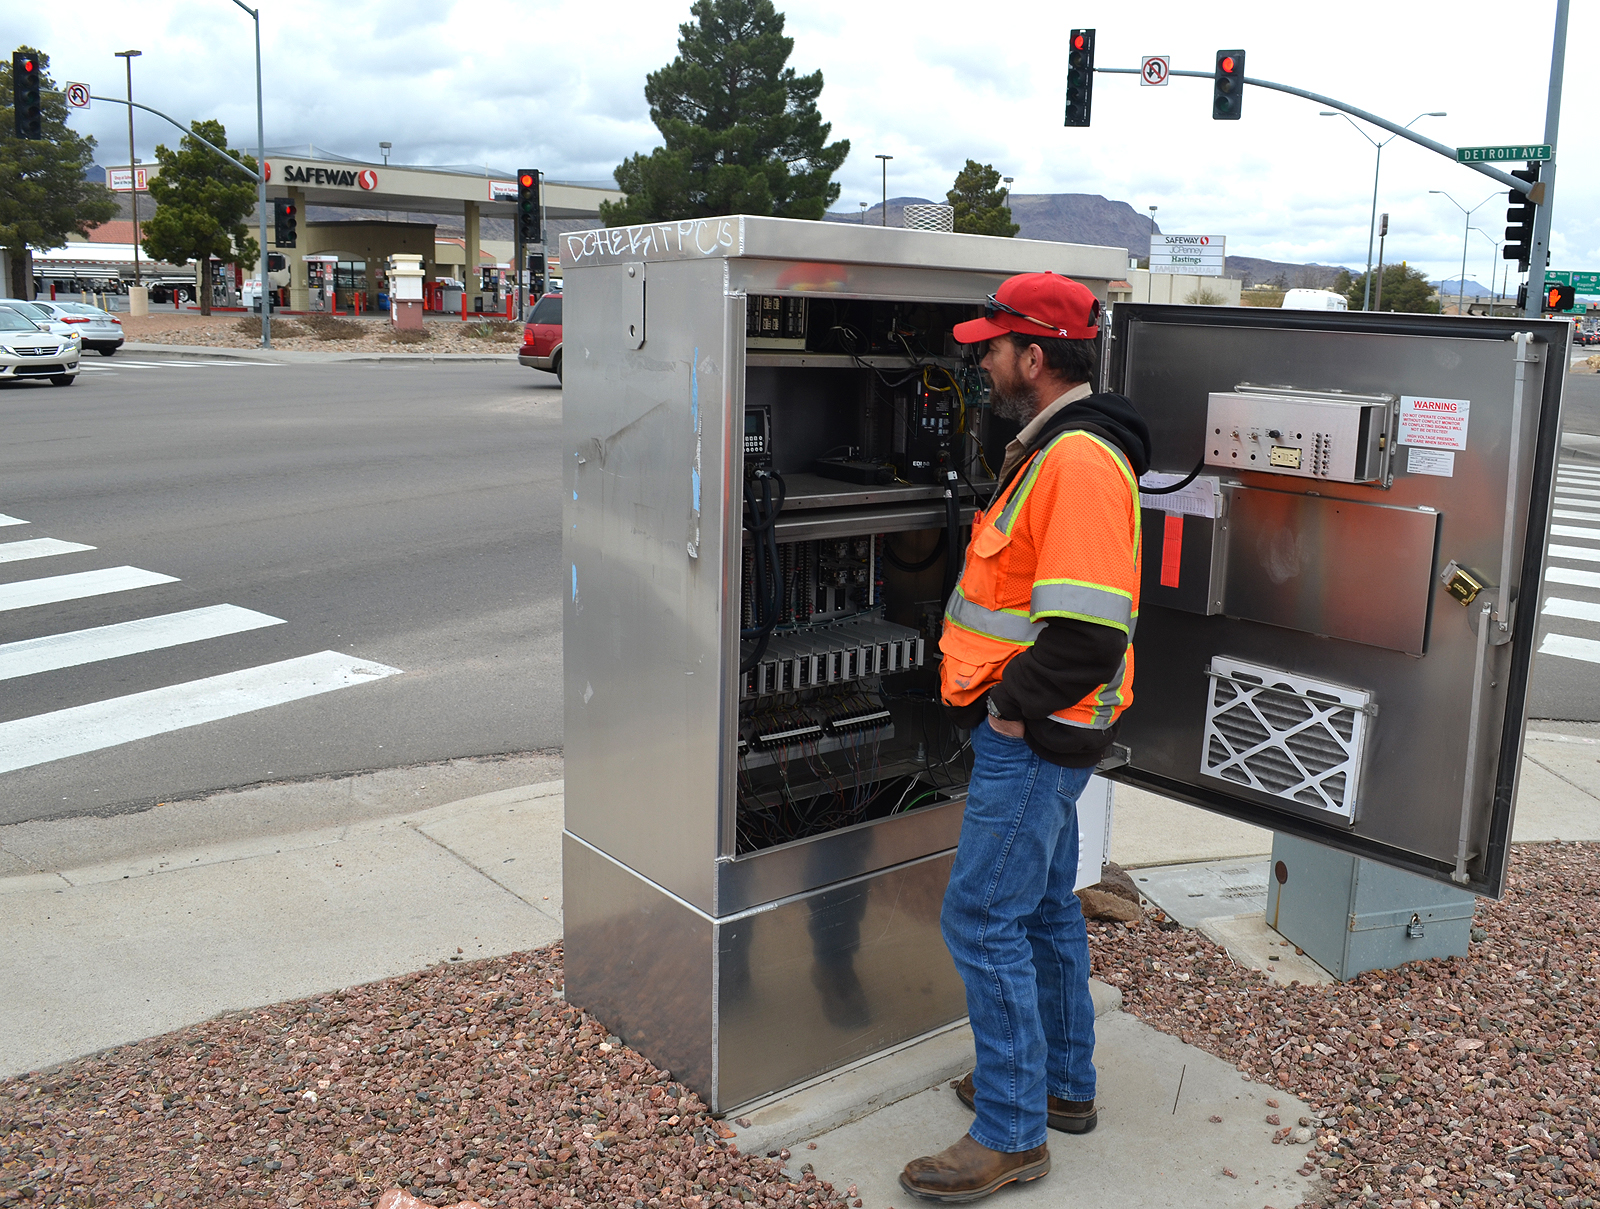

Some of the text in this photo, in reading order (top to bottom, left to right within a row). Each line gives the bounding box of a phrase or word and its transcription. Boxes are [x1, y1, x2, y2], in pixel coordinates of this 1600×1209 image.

[1464, 148, 1544, 160] DETROIT AVE
[284, 165, 358, 186] SAFEWAY
[1172, 256, 1201, 264] Hastings
[1414, 401, 1457, 411] WARNING
